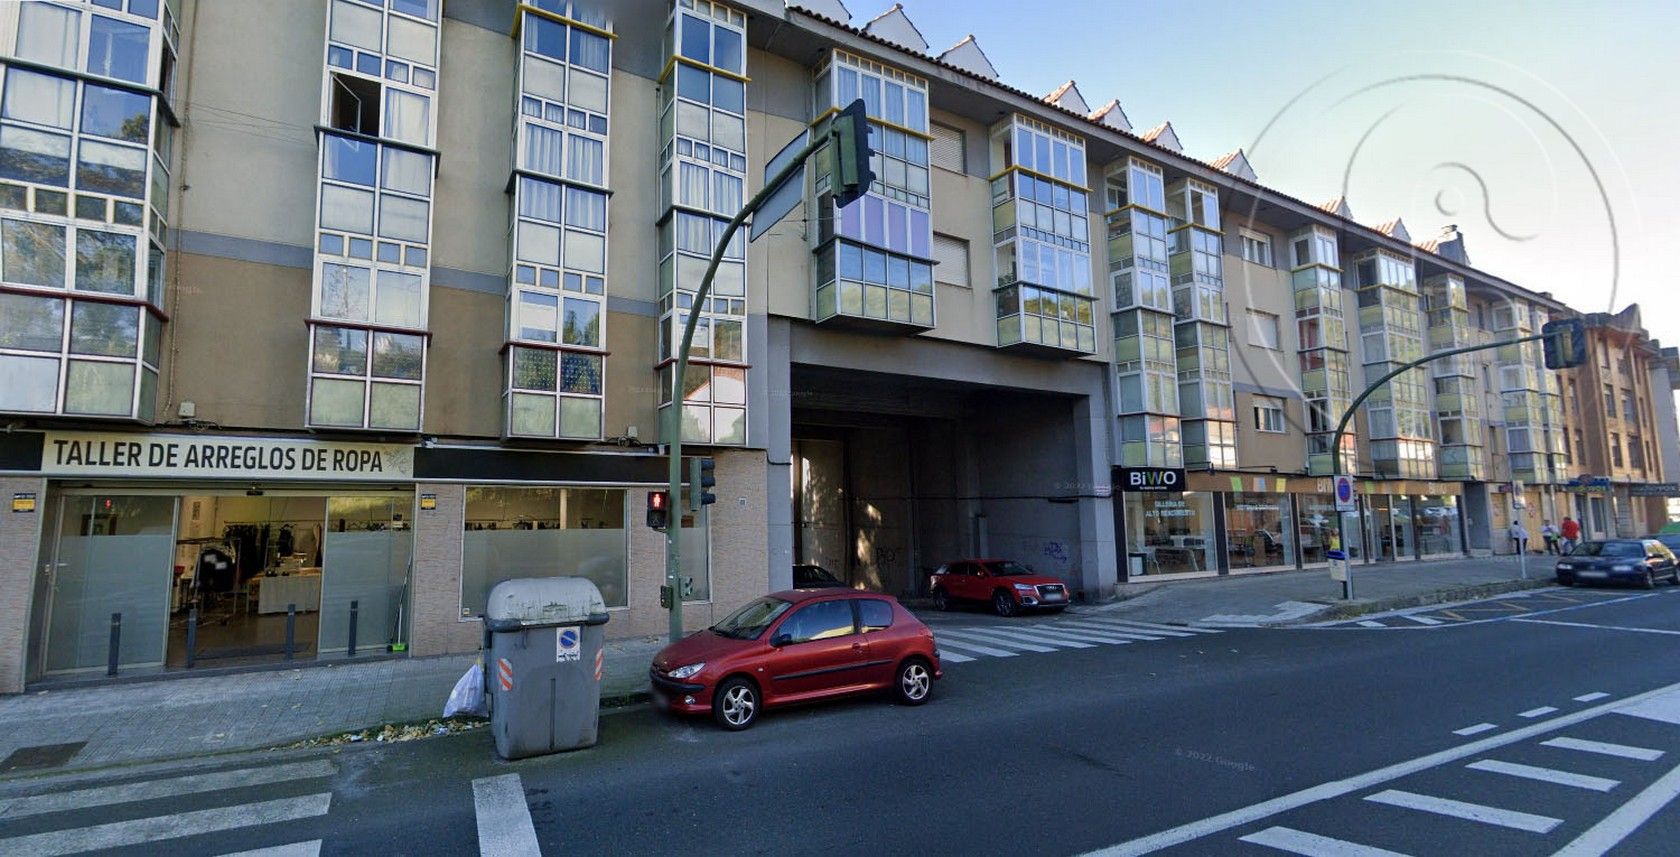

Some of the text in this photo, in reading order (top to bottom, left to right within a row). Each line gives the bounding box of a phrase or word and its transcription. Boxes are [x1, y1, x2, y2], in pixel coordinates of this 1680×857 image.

[53, 440, 383, 473] TALLER DE ARREGLOS DE ROPA
[1130, 471, 1177, 486] BiWO
